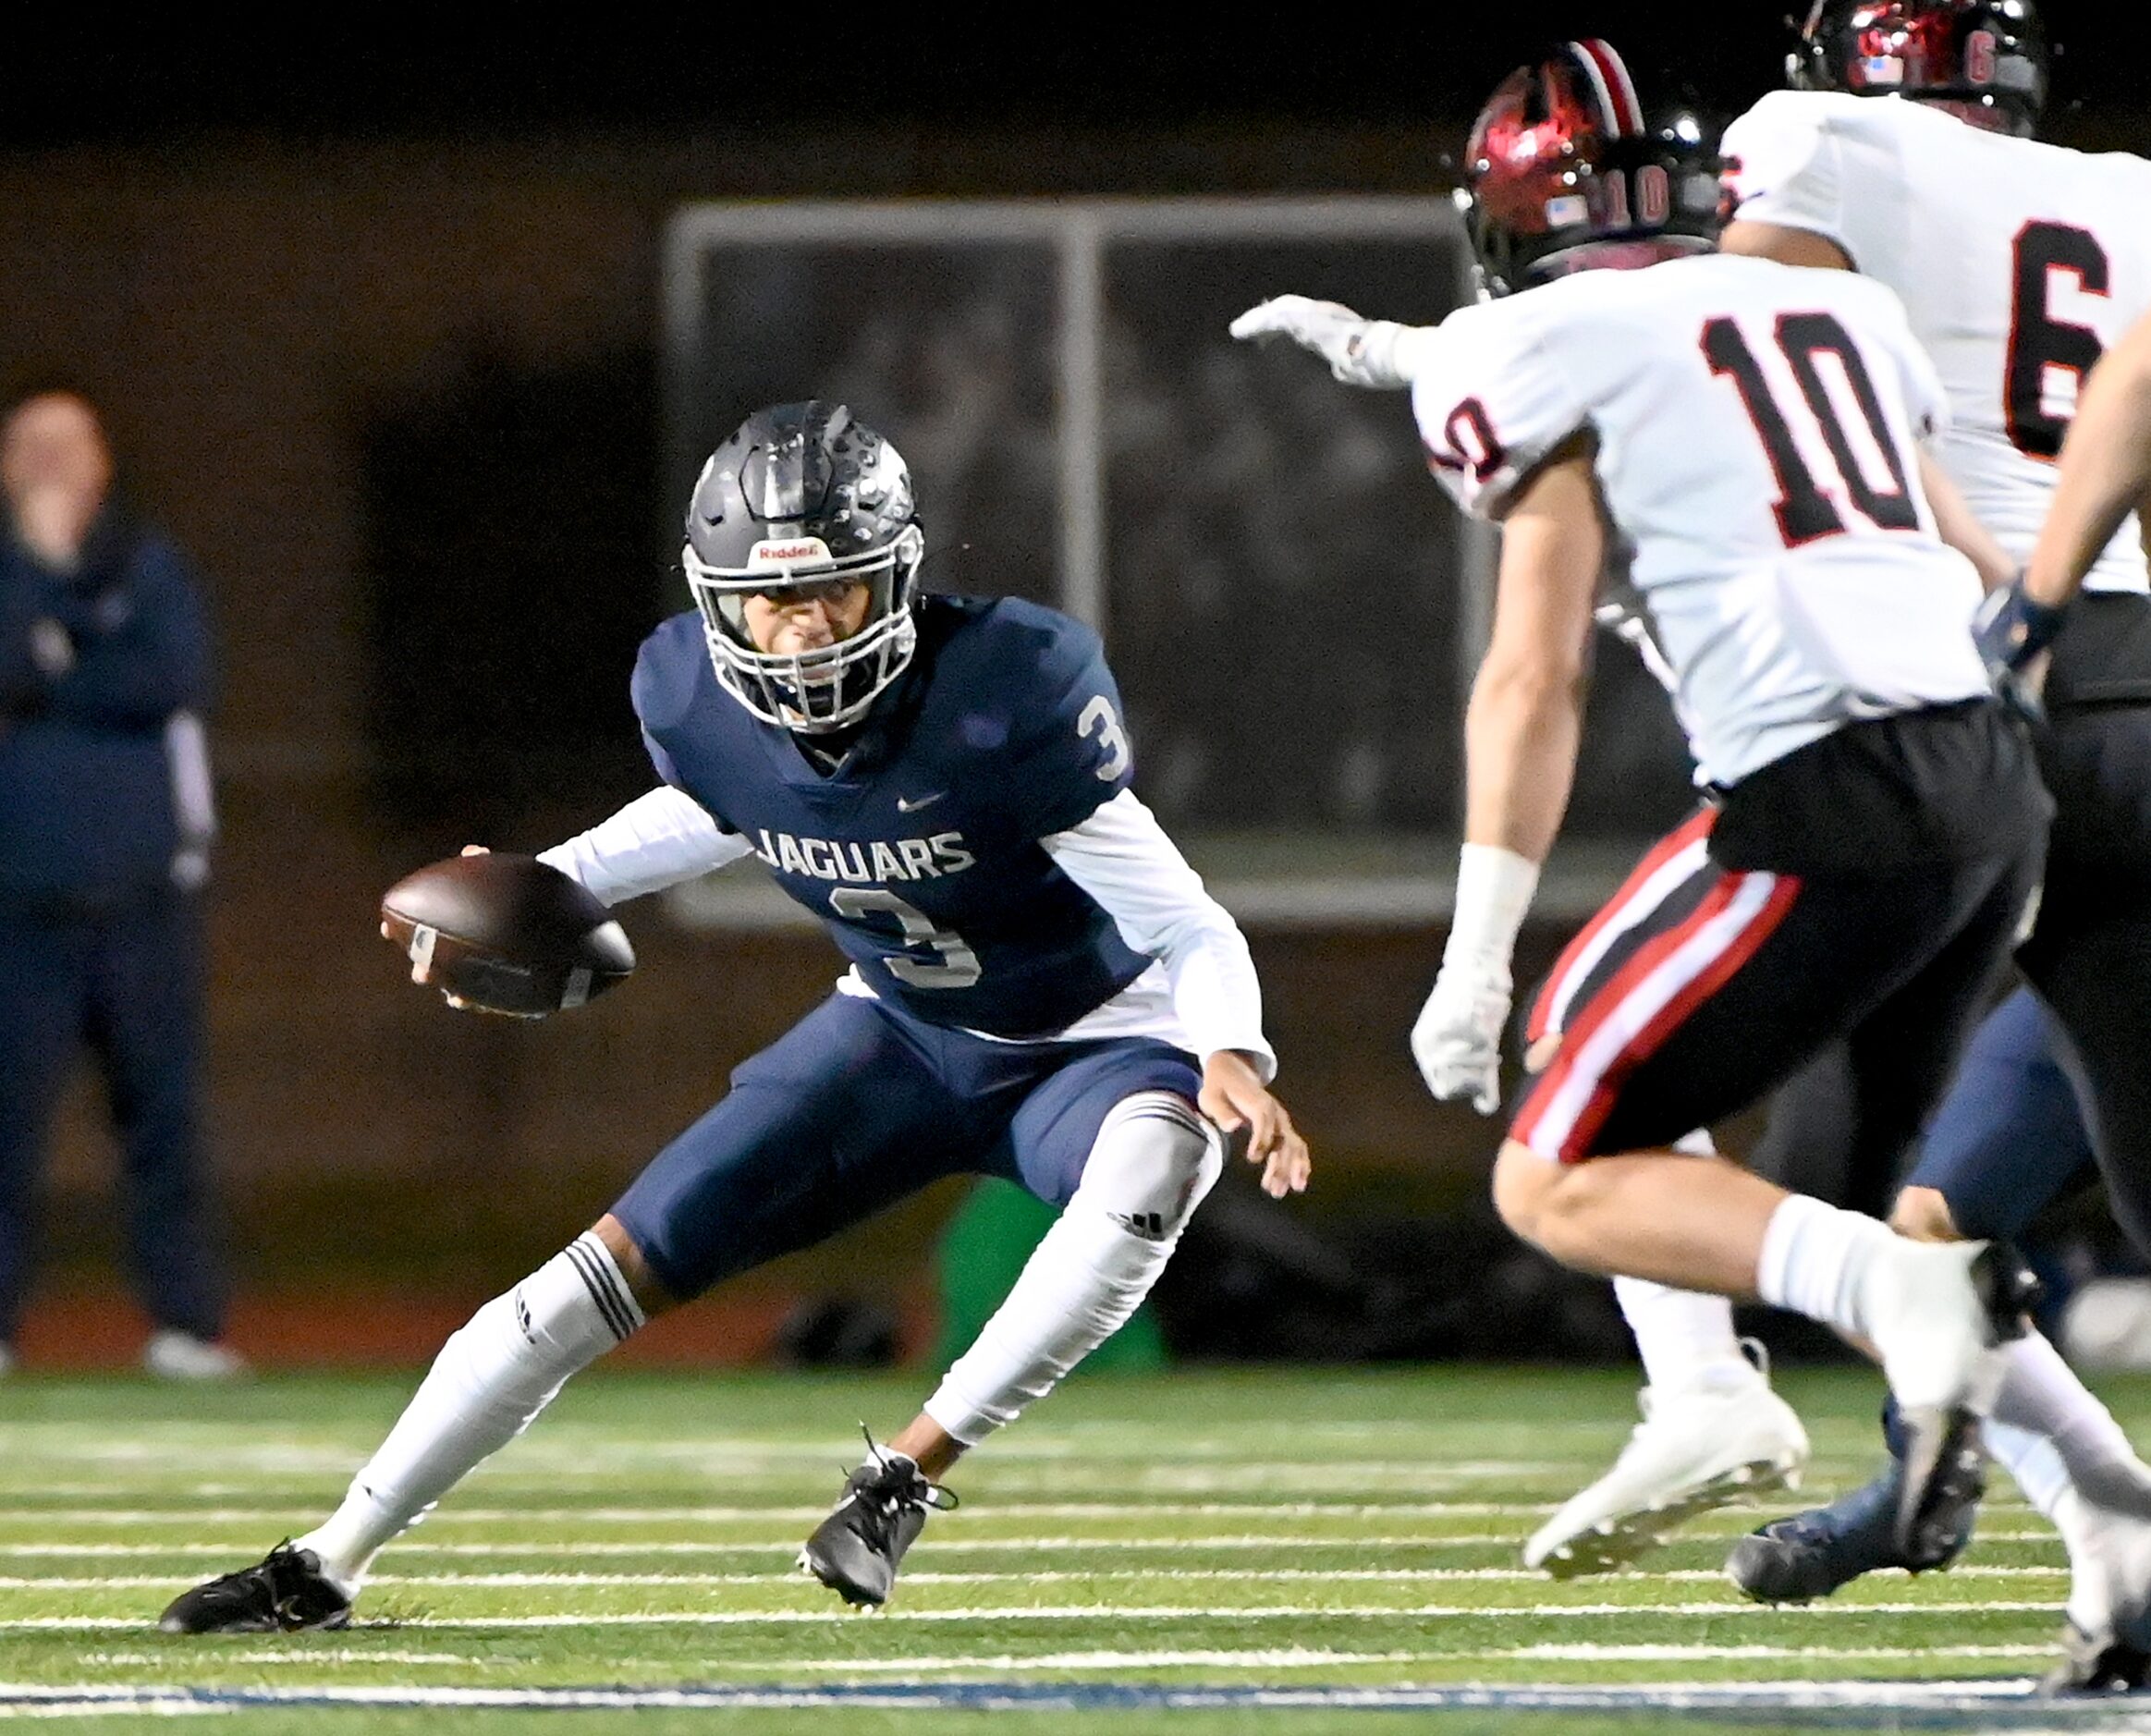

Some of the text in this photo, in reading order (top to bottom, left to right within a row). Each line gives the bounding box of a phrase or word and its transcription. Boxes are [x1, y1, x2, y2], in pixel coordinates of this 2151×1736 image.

[1965, 29, 1996, 85] 6
[1604, 165, 1669, 229] 10
[2003, 218, 2111, 462] 6
[1699, 312, 1920, 548] 10
[1077, 694, 1129, 782] 3
[756, 828, 976, 882] JAGUARS
[828, 886, 983, 989] 3
